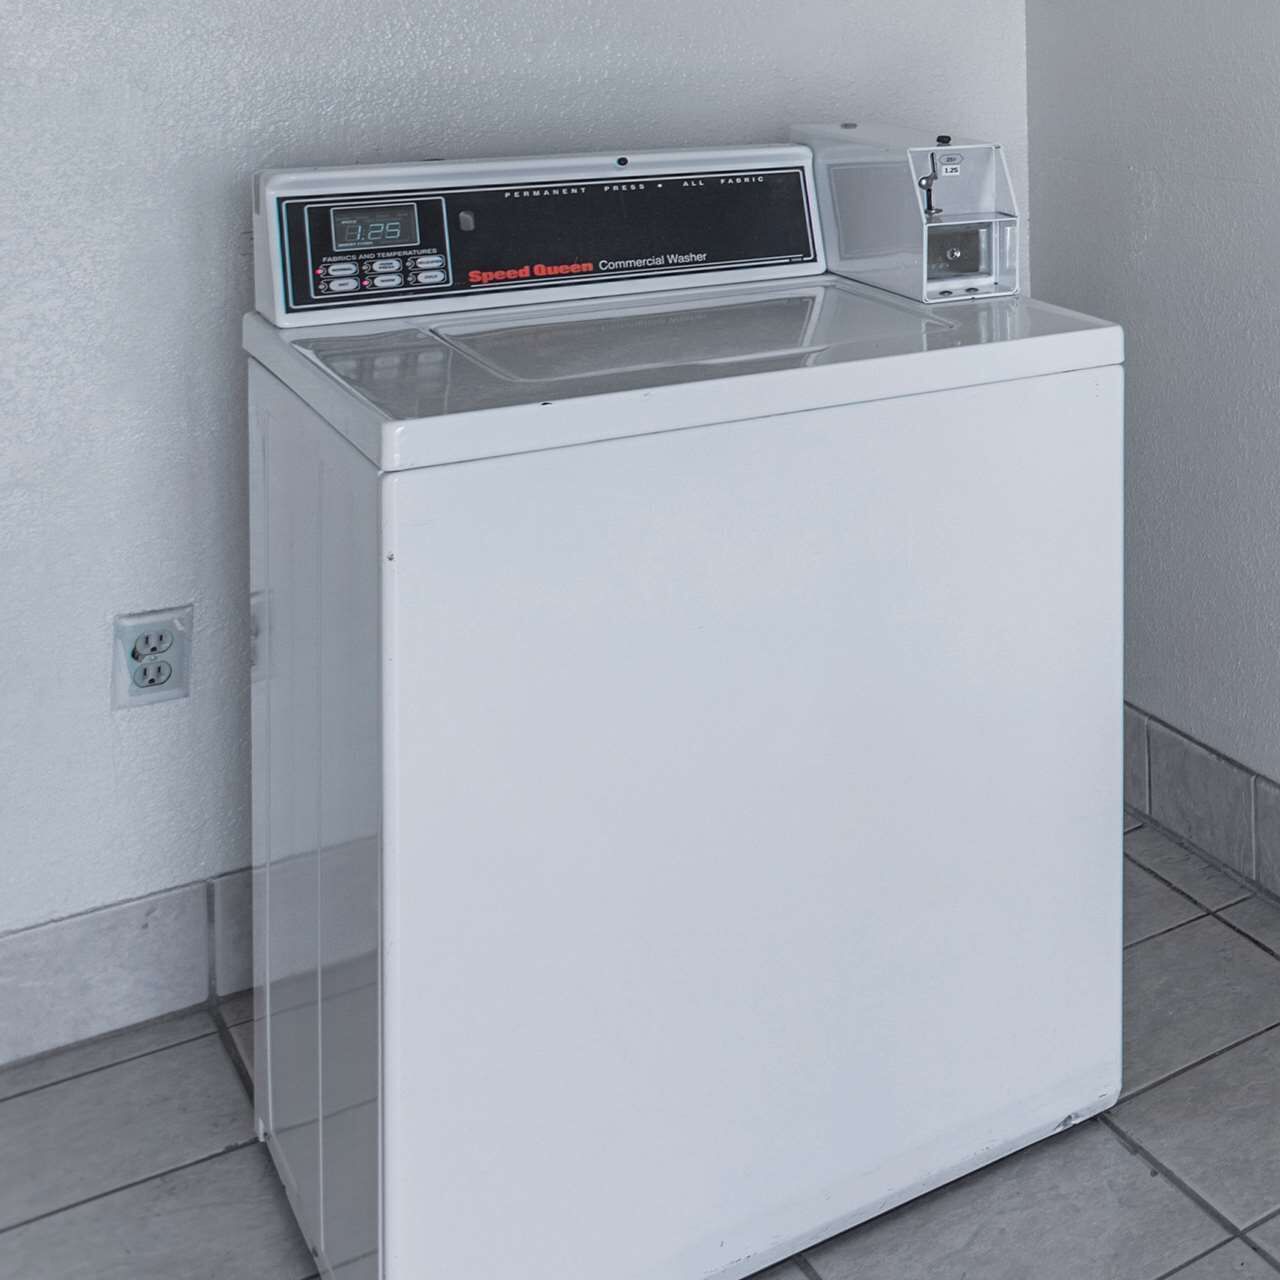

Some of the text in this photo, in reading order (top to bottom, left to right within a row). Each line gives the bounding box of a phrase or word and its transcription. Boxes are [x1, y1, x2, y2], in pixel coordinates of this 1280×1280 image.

[504, 175, 765, 199] PERMANENT PRESS ALL FABRIC
[356, 222, 401, 240] 1.25
[322, 248, 438, 262] FABRICS AND TEMPERATURES
[599, 252, 707, 271] Commercial Washer
[468, 260, 593, 284] Speed Queen
